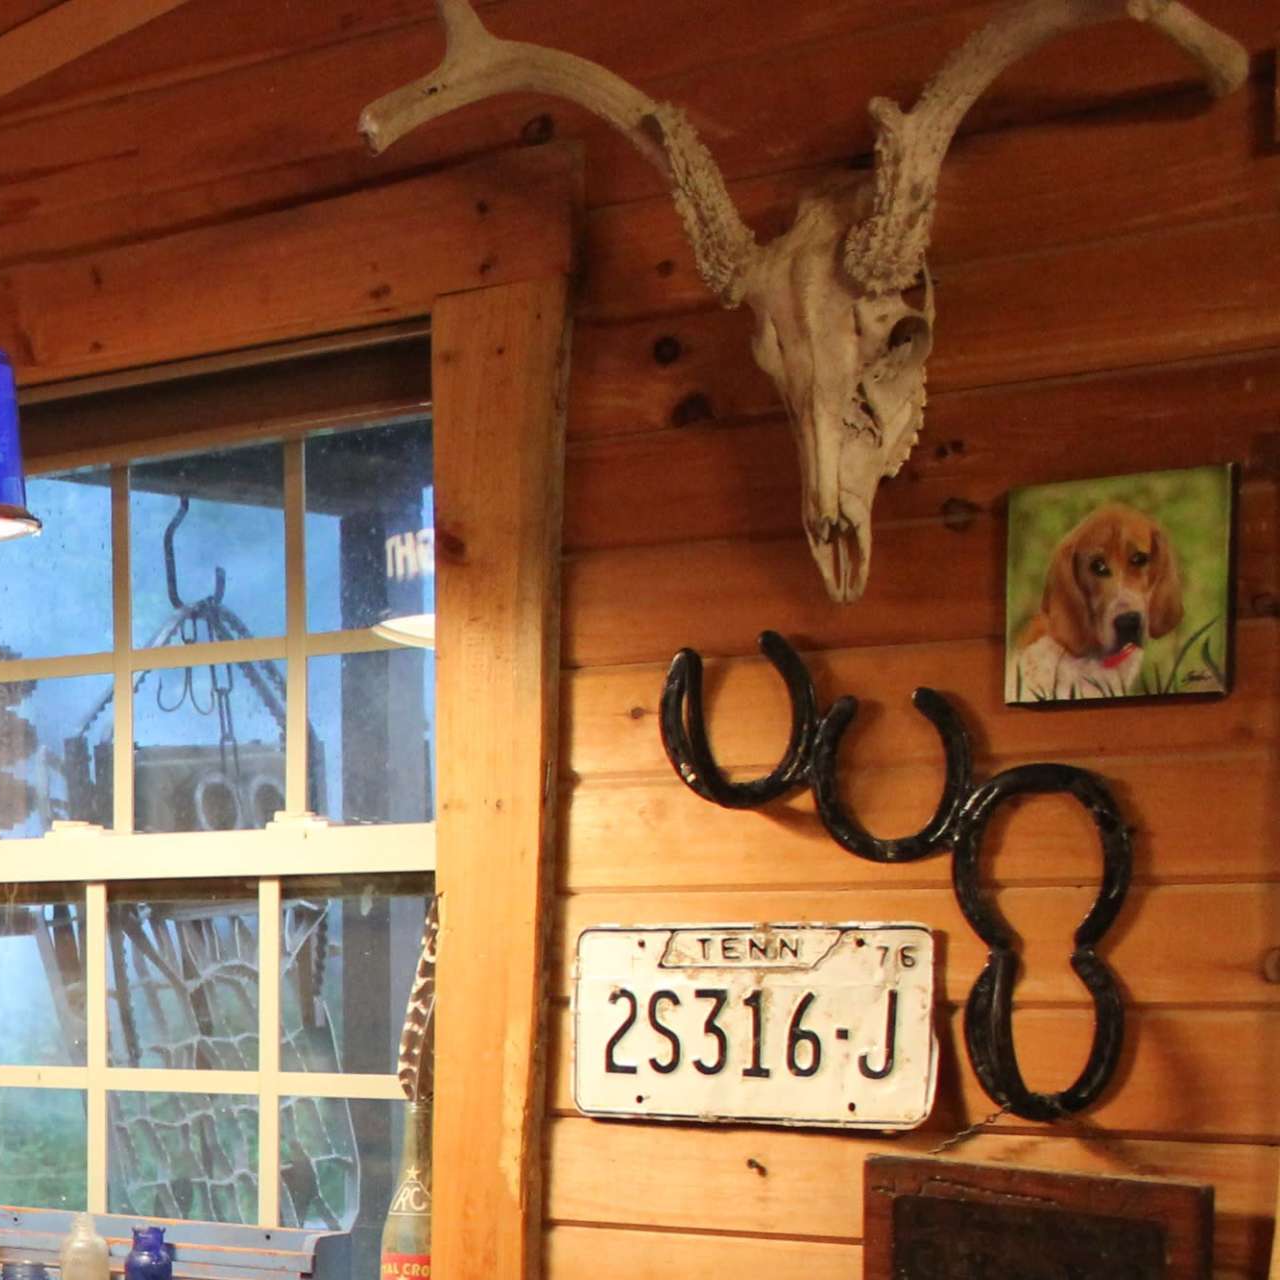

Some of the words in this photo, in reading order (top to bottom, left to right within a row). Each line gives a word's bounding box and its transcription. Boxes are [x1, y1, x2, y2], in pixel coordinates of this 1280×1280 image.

[697, 937, 802, 961] TENN
[875, 944, 918, 968] 76
[604, 987, 899, 1081] 2S316-J
[393, 1186, 429, 1212] RC
